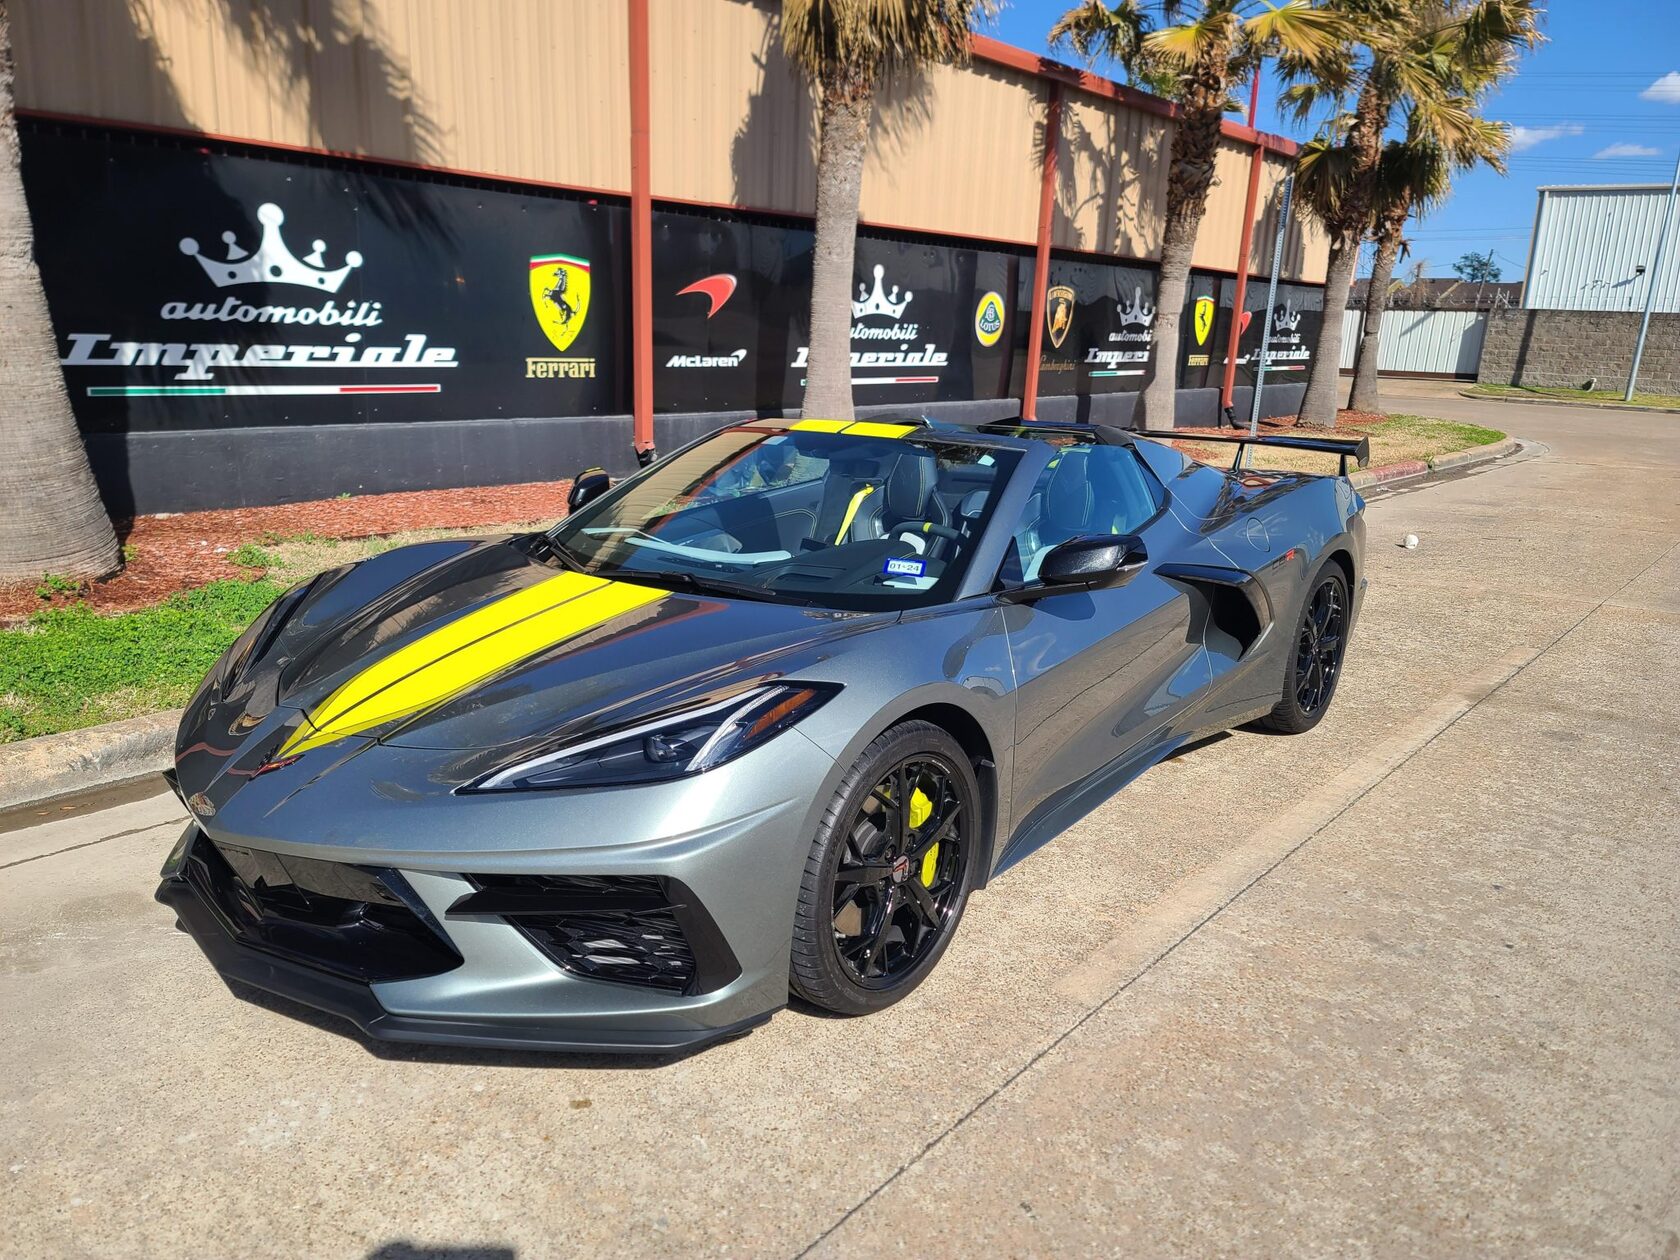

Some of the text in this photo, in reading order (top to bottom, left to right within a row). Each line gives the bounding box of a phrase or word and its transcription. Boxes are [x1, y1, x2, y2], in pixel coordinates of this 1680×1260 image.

[160, 296, 383, 327] automobili
[850, 322, 918, 340] tomobili
[980, 319, 1001, 331] LOTUS
[1108, 330, 1153, 342] automobi
[60, 332, 459, 380] Imperiale
[665, 354, 741, 367] McLaren
[791, 344, 948, 367] Ieriale
[1084, 345, 1150, 369] Imperi
[1251, 345, 1311, 365] Iperiale
[525, 357, 596, 378] Ferrari
